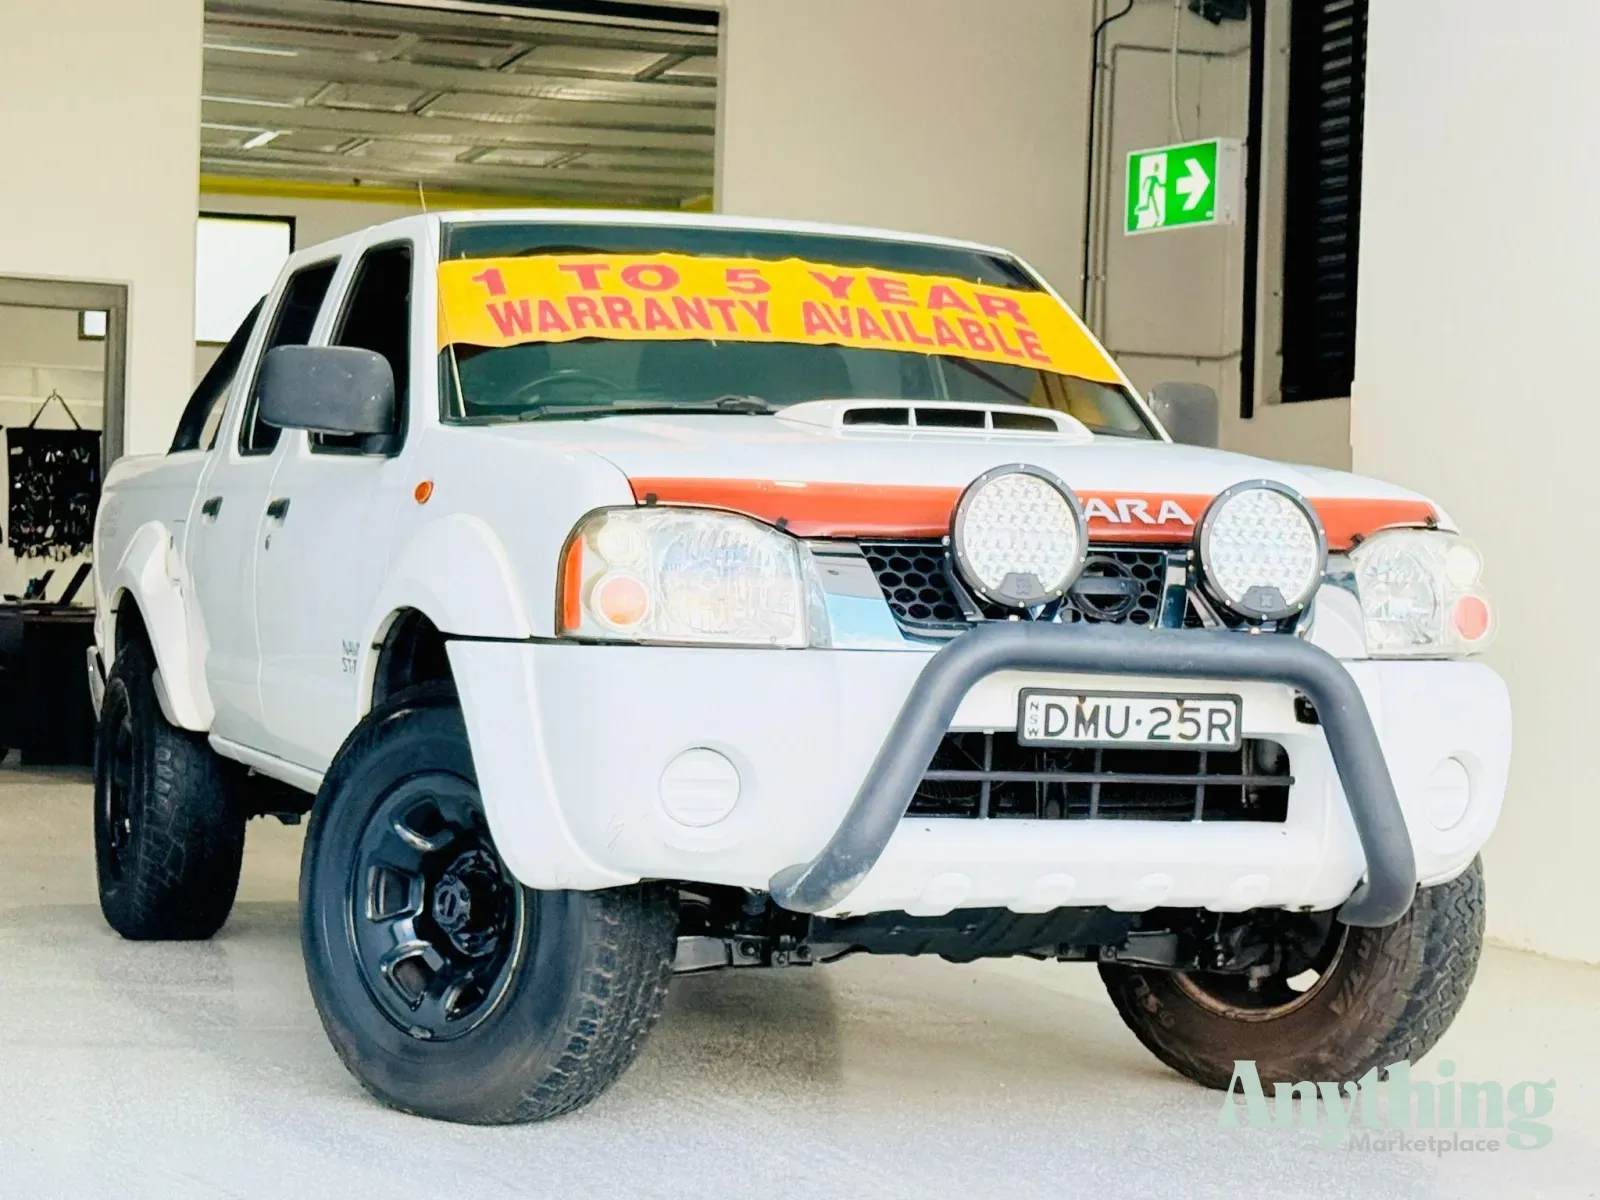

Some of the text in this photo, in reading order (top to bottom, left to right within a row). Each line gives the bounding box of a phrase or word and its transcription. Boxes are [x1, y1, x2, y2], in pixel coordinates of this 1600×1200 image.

[472, 263, 1029, 327] 1 TO 5 YEAR
[486, 296, 1053, 365] WARRANTY AVAILABLE
[1077, 497, 1196, 525] ARA
